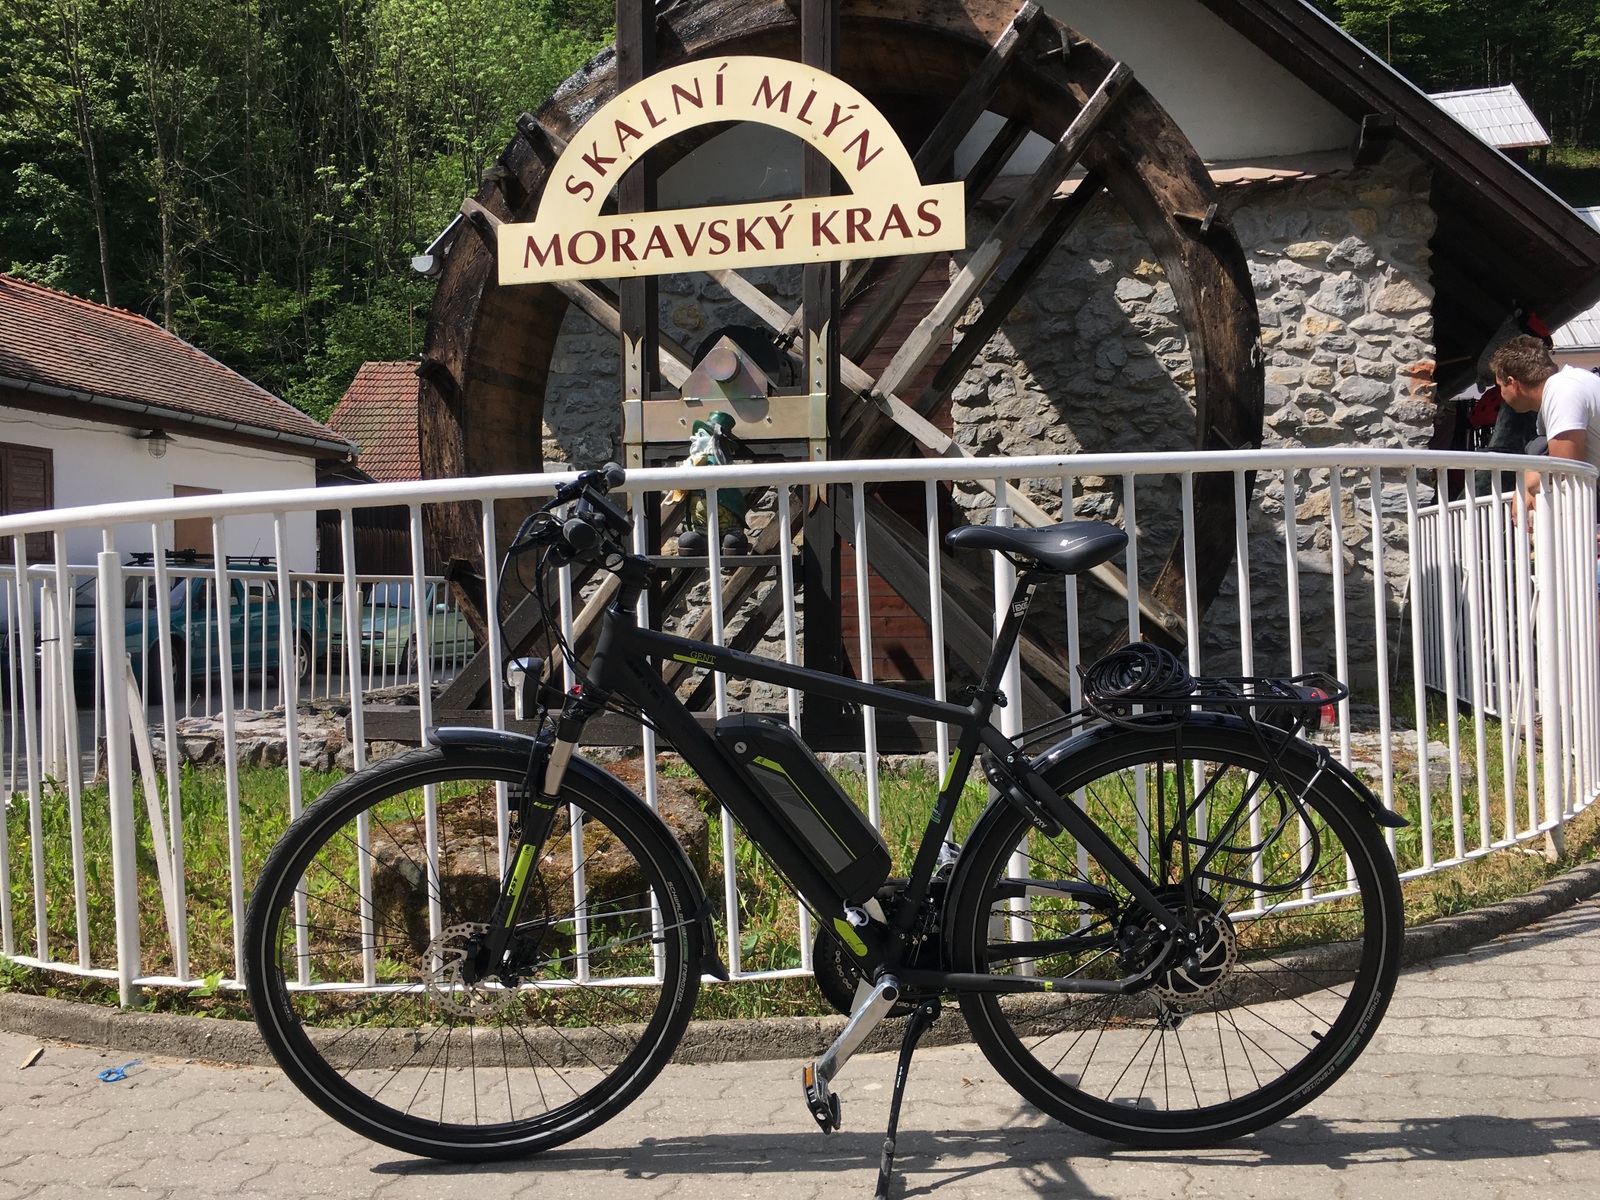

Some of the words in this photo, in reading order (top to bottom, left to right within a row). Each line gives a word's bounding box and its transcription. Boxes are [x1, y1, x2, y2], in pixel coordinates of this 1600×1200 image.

[565, 62, 728, 203] SKALNÍ
[751, 75, 884, 172] MLÝN
[523, 203, 794, 269] MORAVSKÝ
[811, 199, 942, 247] KRAS
[690, 650, 717, 662] GENT
[1033, 815, 1048, 828] AXA
[1359, 990, 1382, 1034] SCHWALBE
